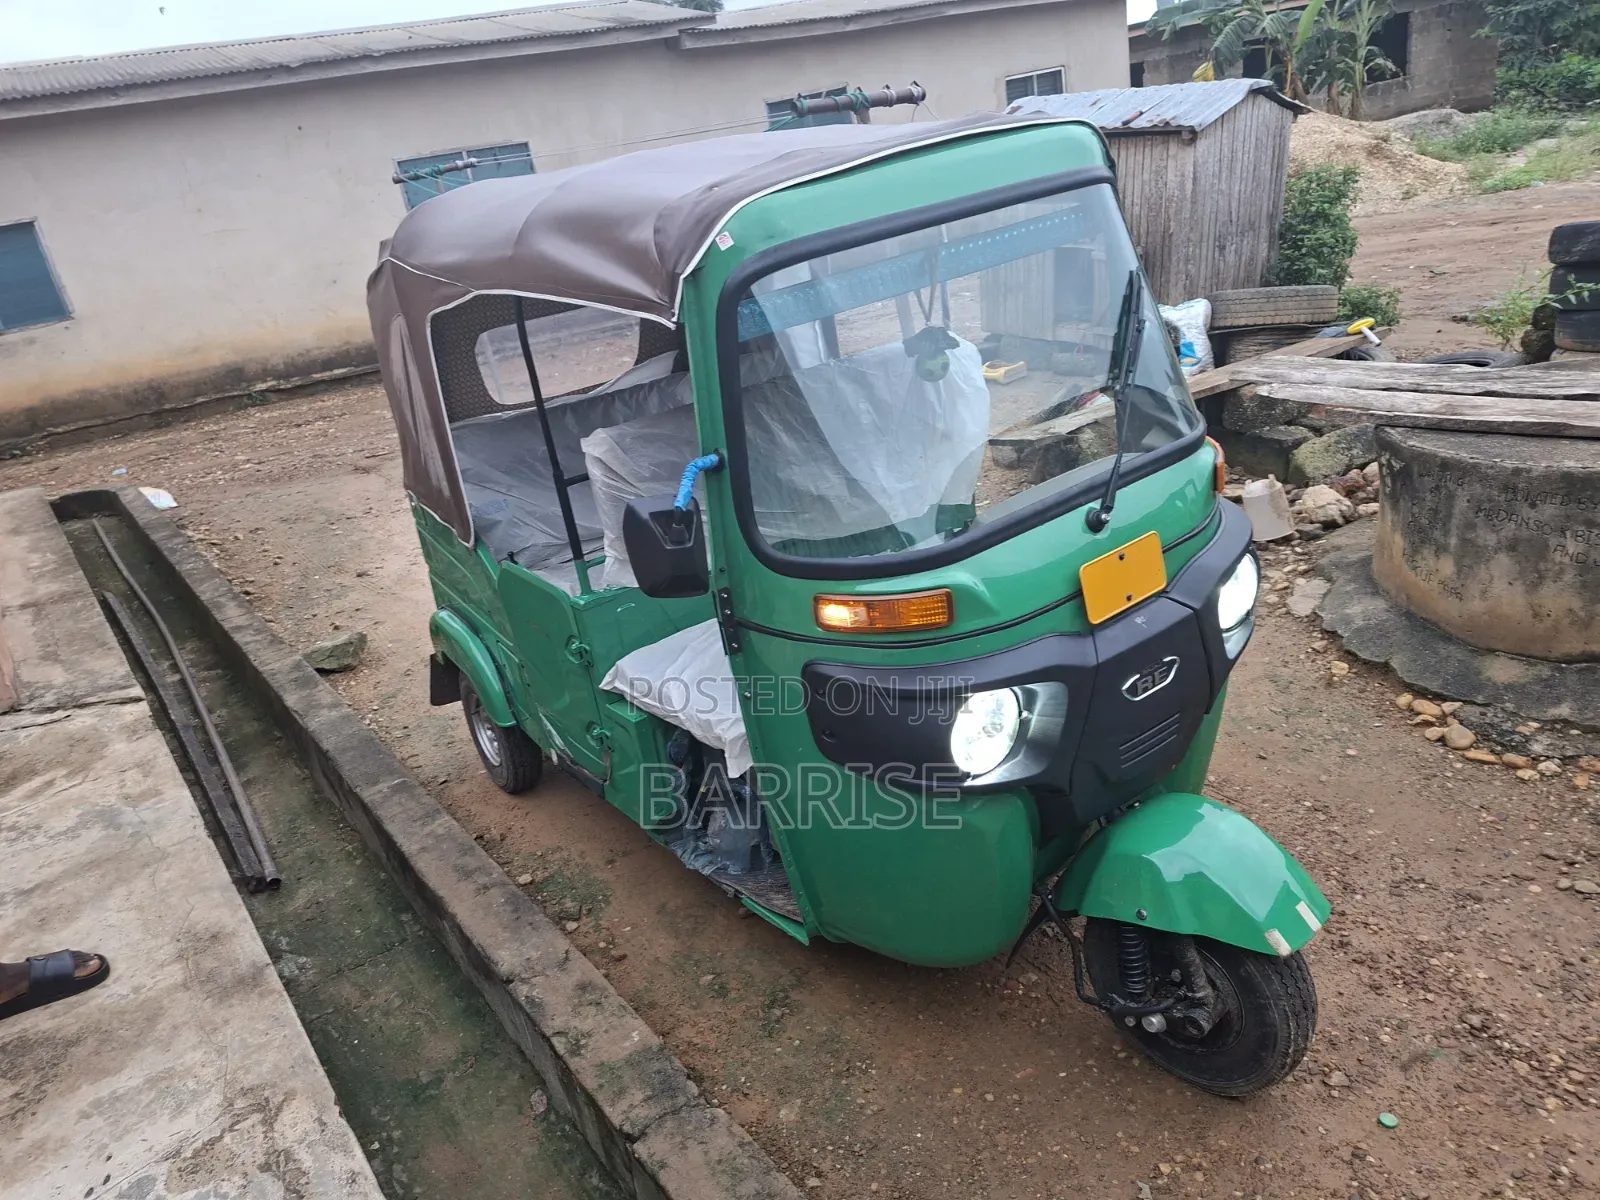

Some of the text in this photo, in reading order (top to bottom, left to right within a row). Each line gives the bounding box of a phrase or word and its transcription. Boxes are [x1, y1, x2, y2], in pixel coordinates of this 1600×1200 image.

[1504, 487, 1571, 506] DONATED
[1551, 544, 1588, 565] AND
[1136, 666, 1168, 696] RE
